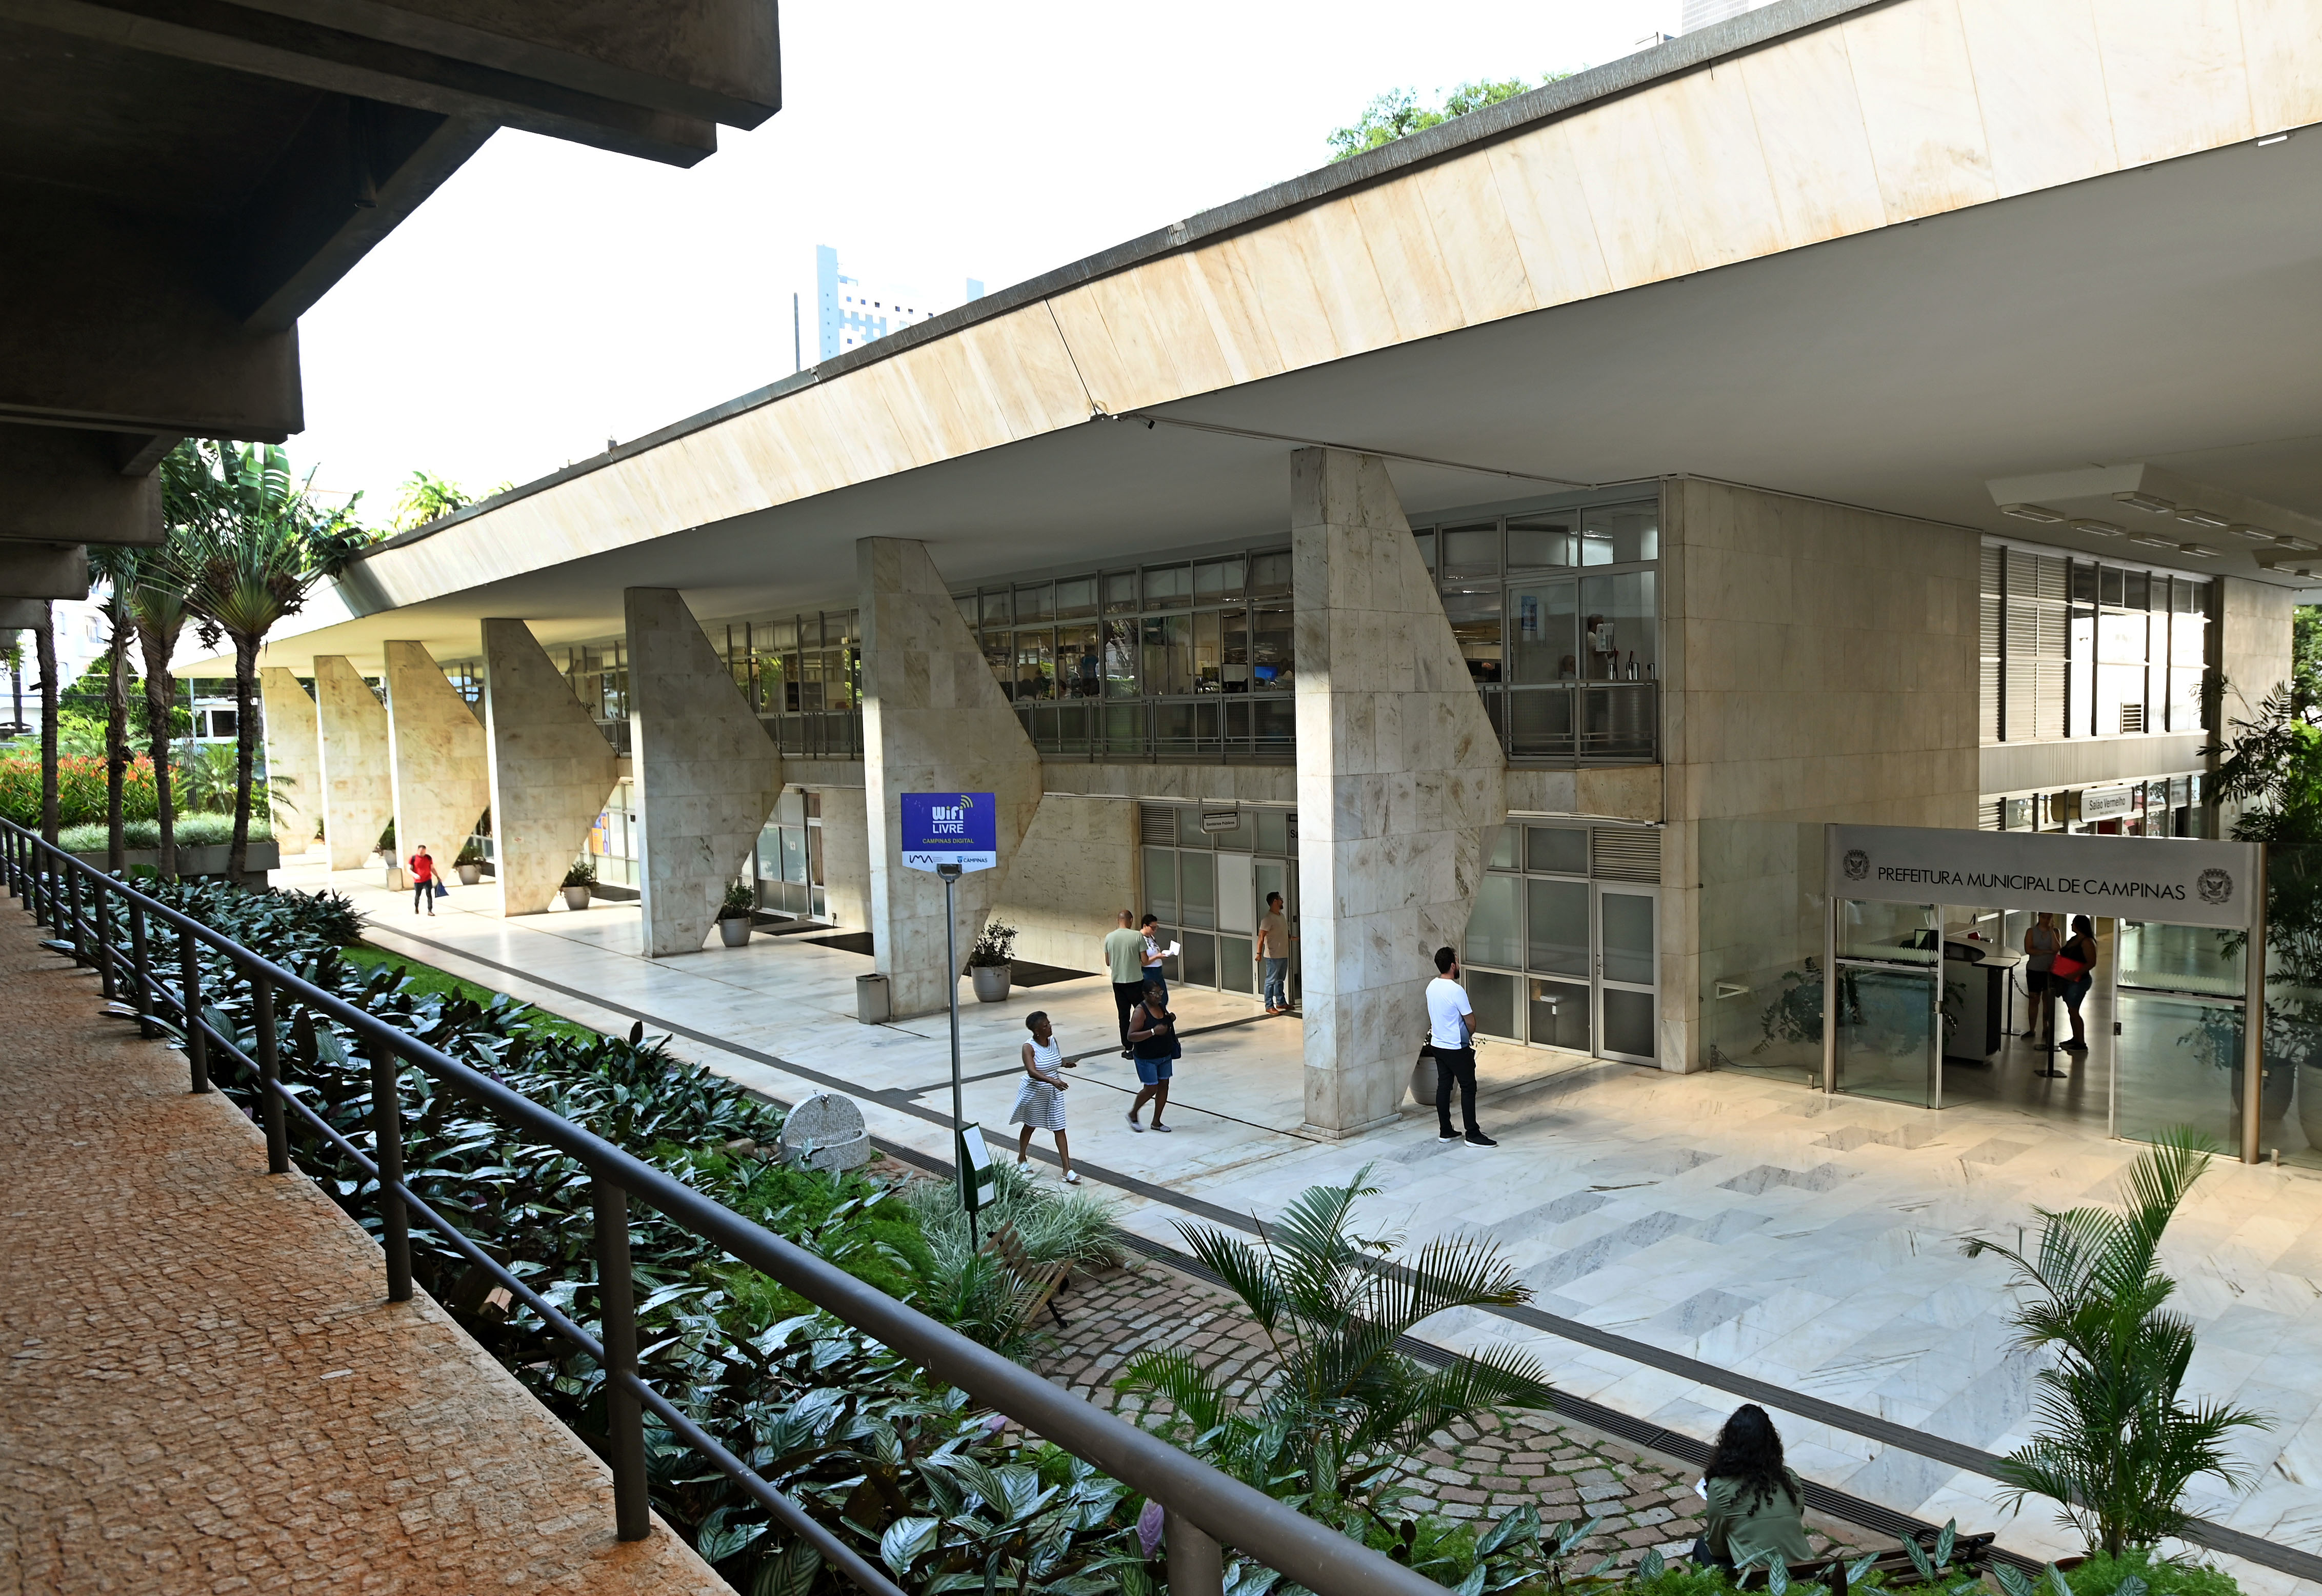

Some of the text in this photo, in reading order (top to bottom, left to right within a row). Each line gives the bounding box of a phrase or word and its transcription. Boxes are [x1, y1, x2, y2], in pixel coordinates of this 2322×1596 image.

[2089, 796, 2125, 811] Salão Vermelho
[932, 824, 964, 834] LIVRE
[1878, 866, 2186, 900] PREFEITURA MUNICIPAL DE CAMPINAS
